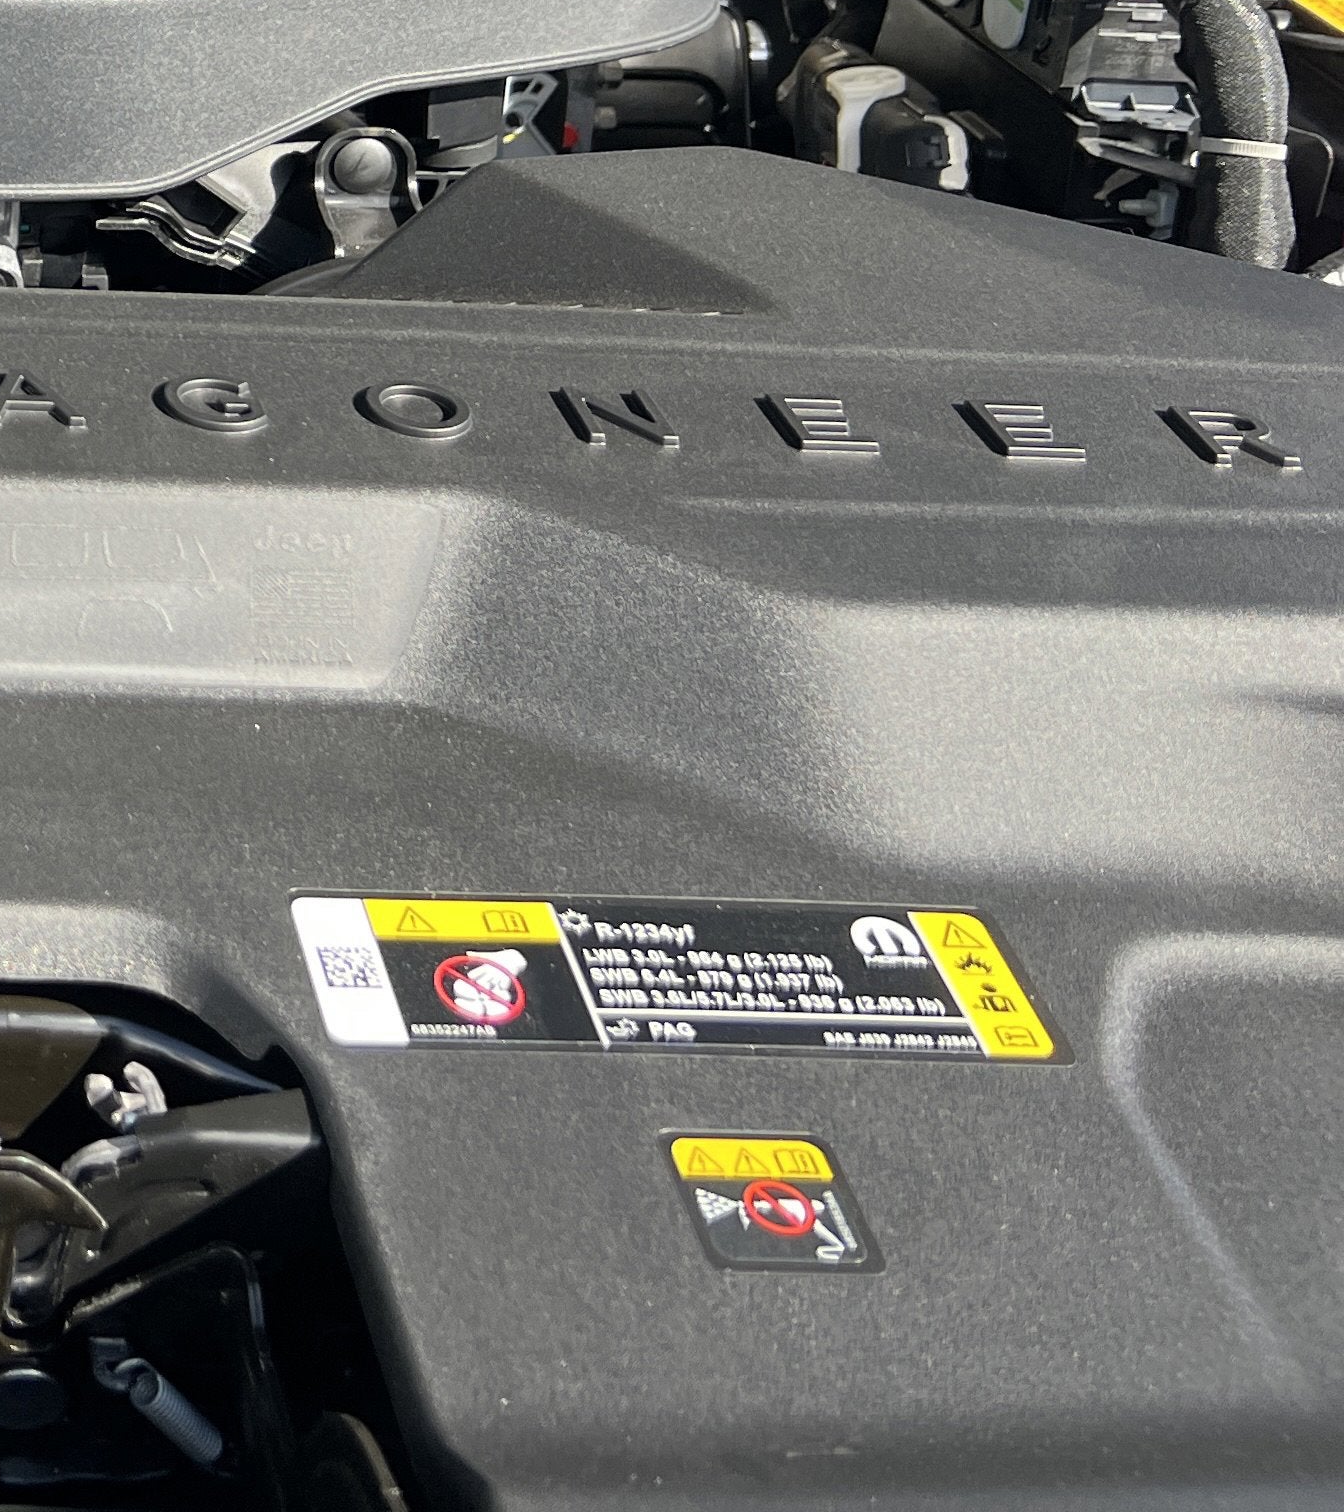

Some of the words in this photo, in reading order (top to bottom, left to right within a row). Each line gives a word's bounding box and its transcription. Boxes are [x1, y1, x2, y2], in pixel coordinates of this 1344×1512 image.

[253, 524, 354, 562] Jeep
[593, 921, 696, 949] R-1234yf
[582, 947, 630, 968] LWB
[630, 948, 676, 970] 3.0L
[803, 953, 834, 976] lb)
[589, 967, 640, 988] SWB
[814, 973, 845, 996] lb)
[598, 988, 650, 1009] SWB
[916, 996, 947, 1017] lb)
[648, 1020, 698, 1042] PAG
